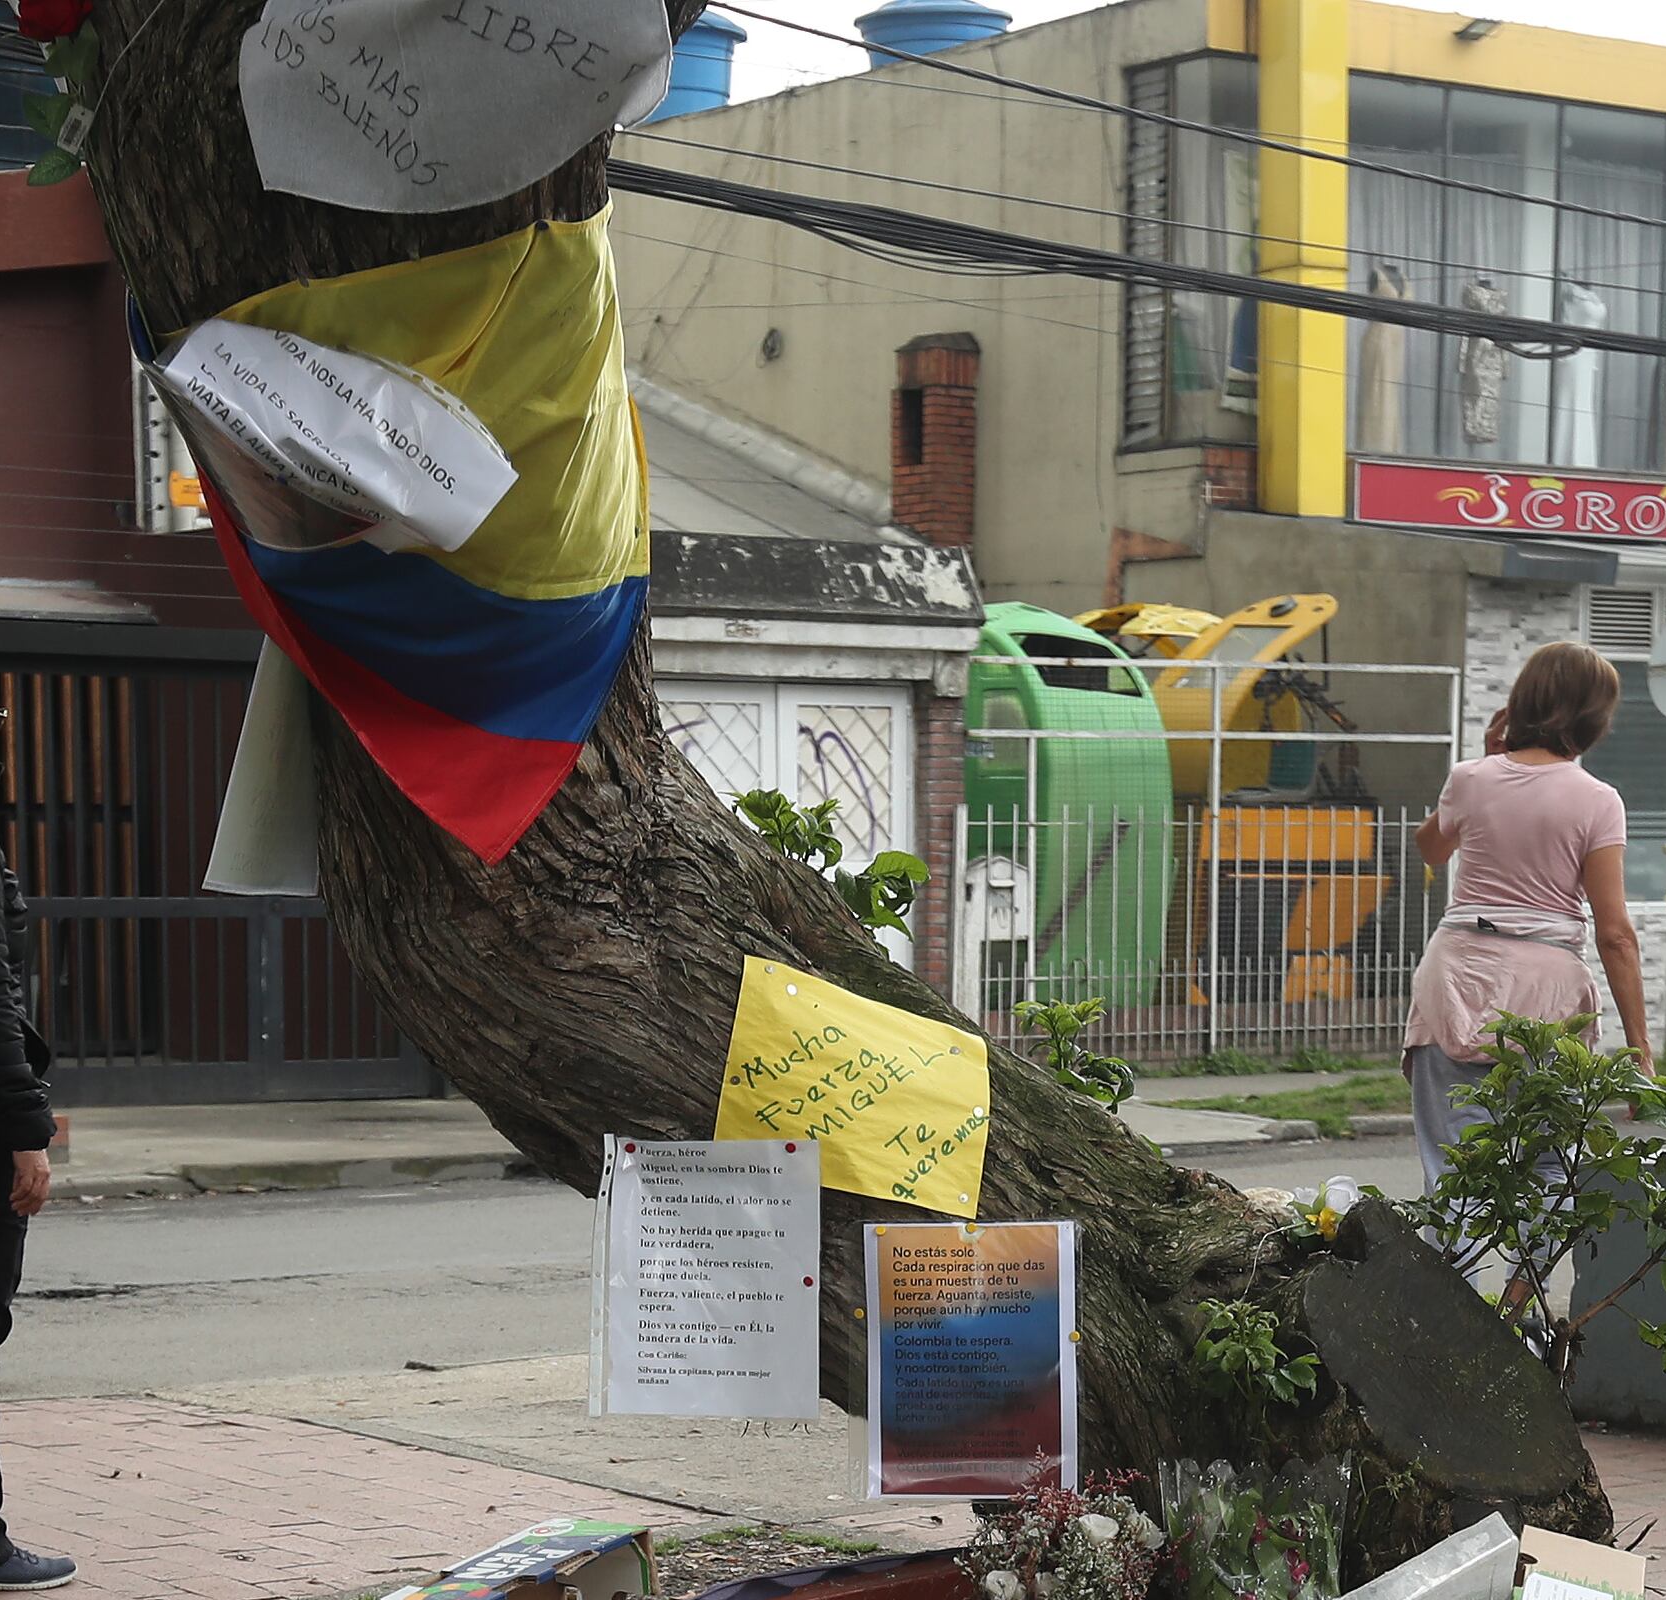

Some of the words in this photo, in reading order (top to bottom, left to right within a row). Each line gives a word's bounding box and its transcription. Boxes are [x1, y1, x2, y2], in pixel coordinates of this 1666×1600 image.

[317, 71, 448, 185] BUENOS
[187, 376, 230, 422] MATA
[229, 418, 248, 439] EL
[215, 343, 232, 366] LA
[234, 363, 268, 395] VIDA
[268, 391, 287, 410] ES
[287, 409, 352, 476] SAGRADA.
[273, 330, 307, 365] VIDA
[306, 359, 337, 388] NOS
[335, 382, 354, 404] LA
[355, 398, 374, 424] HA
[375, 418, 420, 460] DADO
[419, 456, 456, 496] DIOS.
[741, 1025, 847, 1089] Mucha
[805, 1046, 945, 1140] MIGUEL
[885, 1123, 936, 1156] Te
[640, 1145, 676, 1158] Fuerza,
[678, 1147, 707, 1157] héroe
[640, 1163, 678, 1174] Miguel,
[681, 1165, 693, 1173] en
[695, 1164, 705, 1173] la
[707, 1164, 746, 1174] sombra
[748, 1165, 771, 1174] Dios
[773, 1166, 783, 1174] te
[641, 1175, 684, 1186] sostiene,
[640, 1195, 646, 1204] y
[650, 1195, 663, 1203] en
[665, 1194, 688, 1204] cada
[691, 1194, 723, 1205] latido,
[725, 1195, 735, 1204] el
[766, 1197, 780, 1206] no
[782, 1198, 792, 1206] se
[640, 1206, 681, 1217] detiene.
[640, 1225, 656, 1235] No
[658, 1225, 677, 1237] hay
[680, 1225, 712, 1236] herida
[715, 1228, 734, 1239] que
[736, 1229, 772, 1241] apague
[775, 1228, 785, 1238] tu
[640, 1238, 656, 1248] luz
[659, 1239, 714, 1250] verdadera,
[893, 1246, 911, 1258] No
[914, 1246, 947, 1258] estás
[639, 1257, 677, 1269] porque
[679, 1257, 694, 1267] los
[696, 1258, 729, 1268] héroes
[732, 1258, 774, 1270] resisten,
[893, 1260, 925, 1272] Cada
[929, 1260, 994, 1274] respiración
[997, 1261, 1020, 1274] que
[1023, 1259, 1045, 1271] das
[639, 1271, 678, 1282] aunque
[893, 1276, 907, 1287] es
[910, 1276, 932, 1287] una
[936, 1275, 984, 1287] muestra
[988, 1274, 1003, 1286] de
[1006, 1274, 1019, 1286] tu
[639, 1288, 678, 1299] Fuerza,
[681, 1290, 724, 1301] valiente,
[727, 1291, 736, 1300] el
[738, 1291, 773, 1303] pueblo
[775, 1293, 784, 1302] te
[893, 1289, 934, 1301] fuerza.
[992, 1288, 1035, 1301] resiste,
[638, 1303, 675, 1313] espera.
[894, 1304, 937, 1317] porque
[939, 1302, 962, 1315] aún
[989, 1303, 1031, 1314] mucho
[638, 1319, 661, 1330] Dios
[664, 1321, 677, 1330] va
[679, 1320, 717, 1333] contigo
[734, 1324, 746, 1332] en
[766, 1323, 775, 1333] la
[894, 1320, 914, 1332] por
[917, 1318, 944, 1330] vivir.
[638, 1333, 681, 1344] bandera
[684, 1334, 696, 1344] de
[699, 1334, 709, 1344] la
[711, 1335, 737, 1345] vida.
[894, 1334, 952, 1347] Colombia
[955, 1335, 967, 1346] te
[970, 1336, 1013, 1348] espera.
[637, 1350, 655, 1359] Con
[895, 1349, 921, 1360] Dios
[923, 1349, 949, 1360] está
[637, 1365, 667, 1375] Silvana
[669, 1366, 677, 1375] la
[678, 1366, 714, 1377] capitana,
[716, 1369, 735, 1378] para
[737, 1369, 747, 1377] un
[749, 1369, 771, 1379] mejor
[904, 1363, 956, 1374] nosotros
